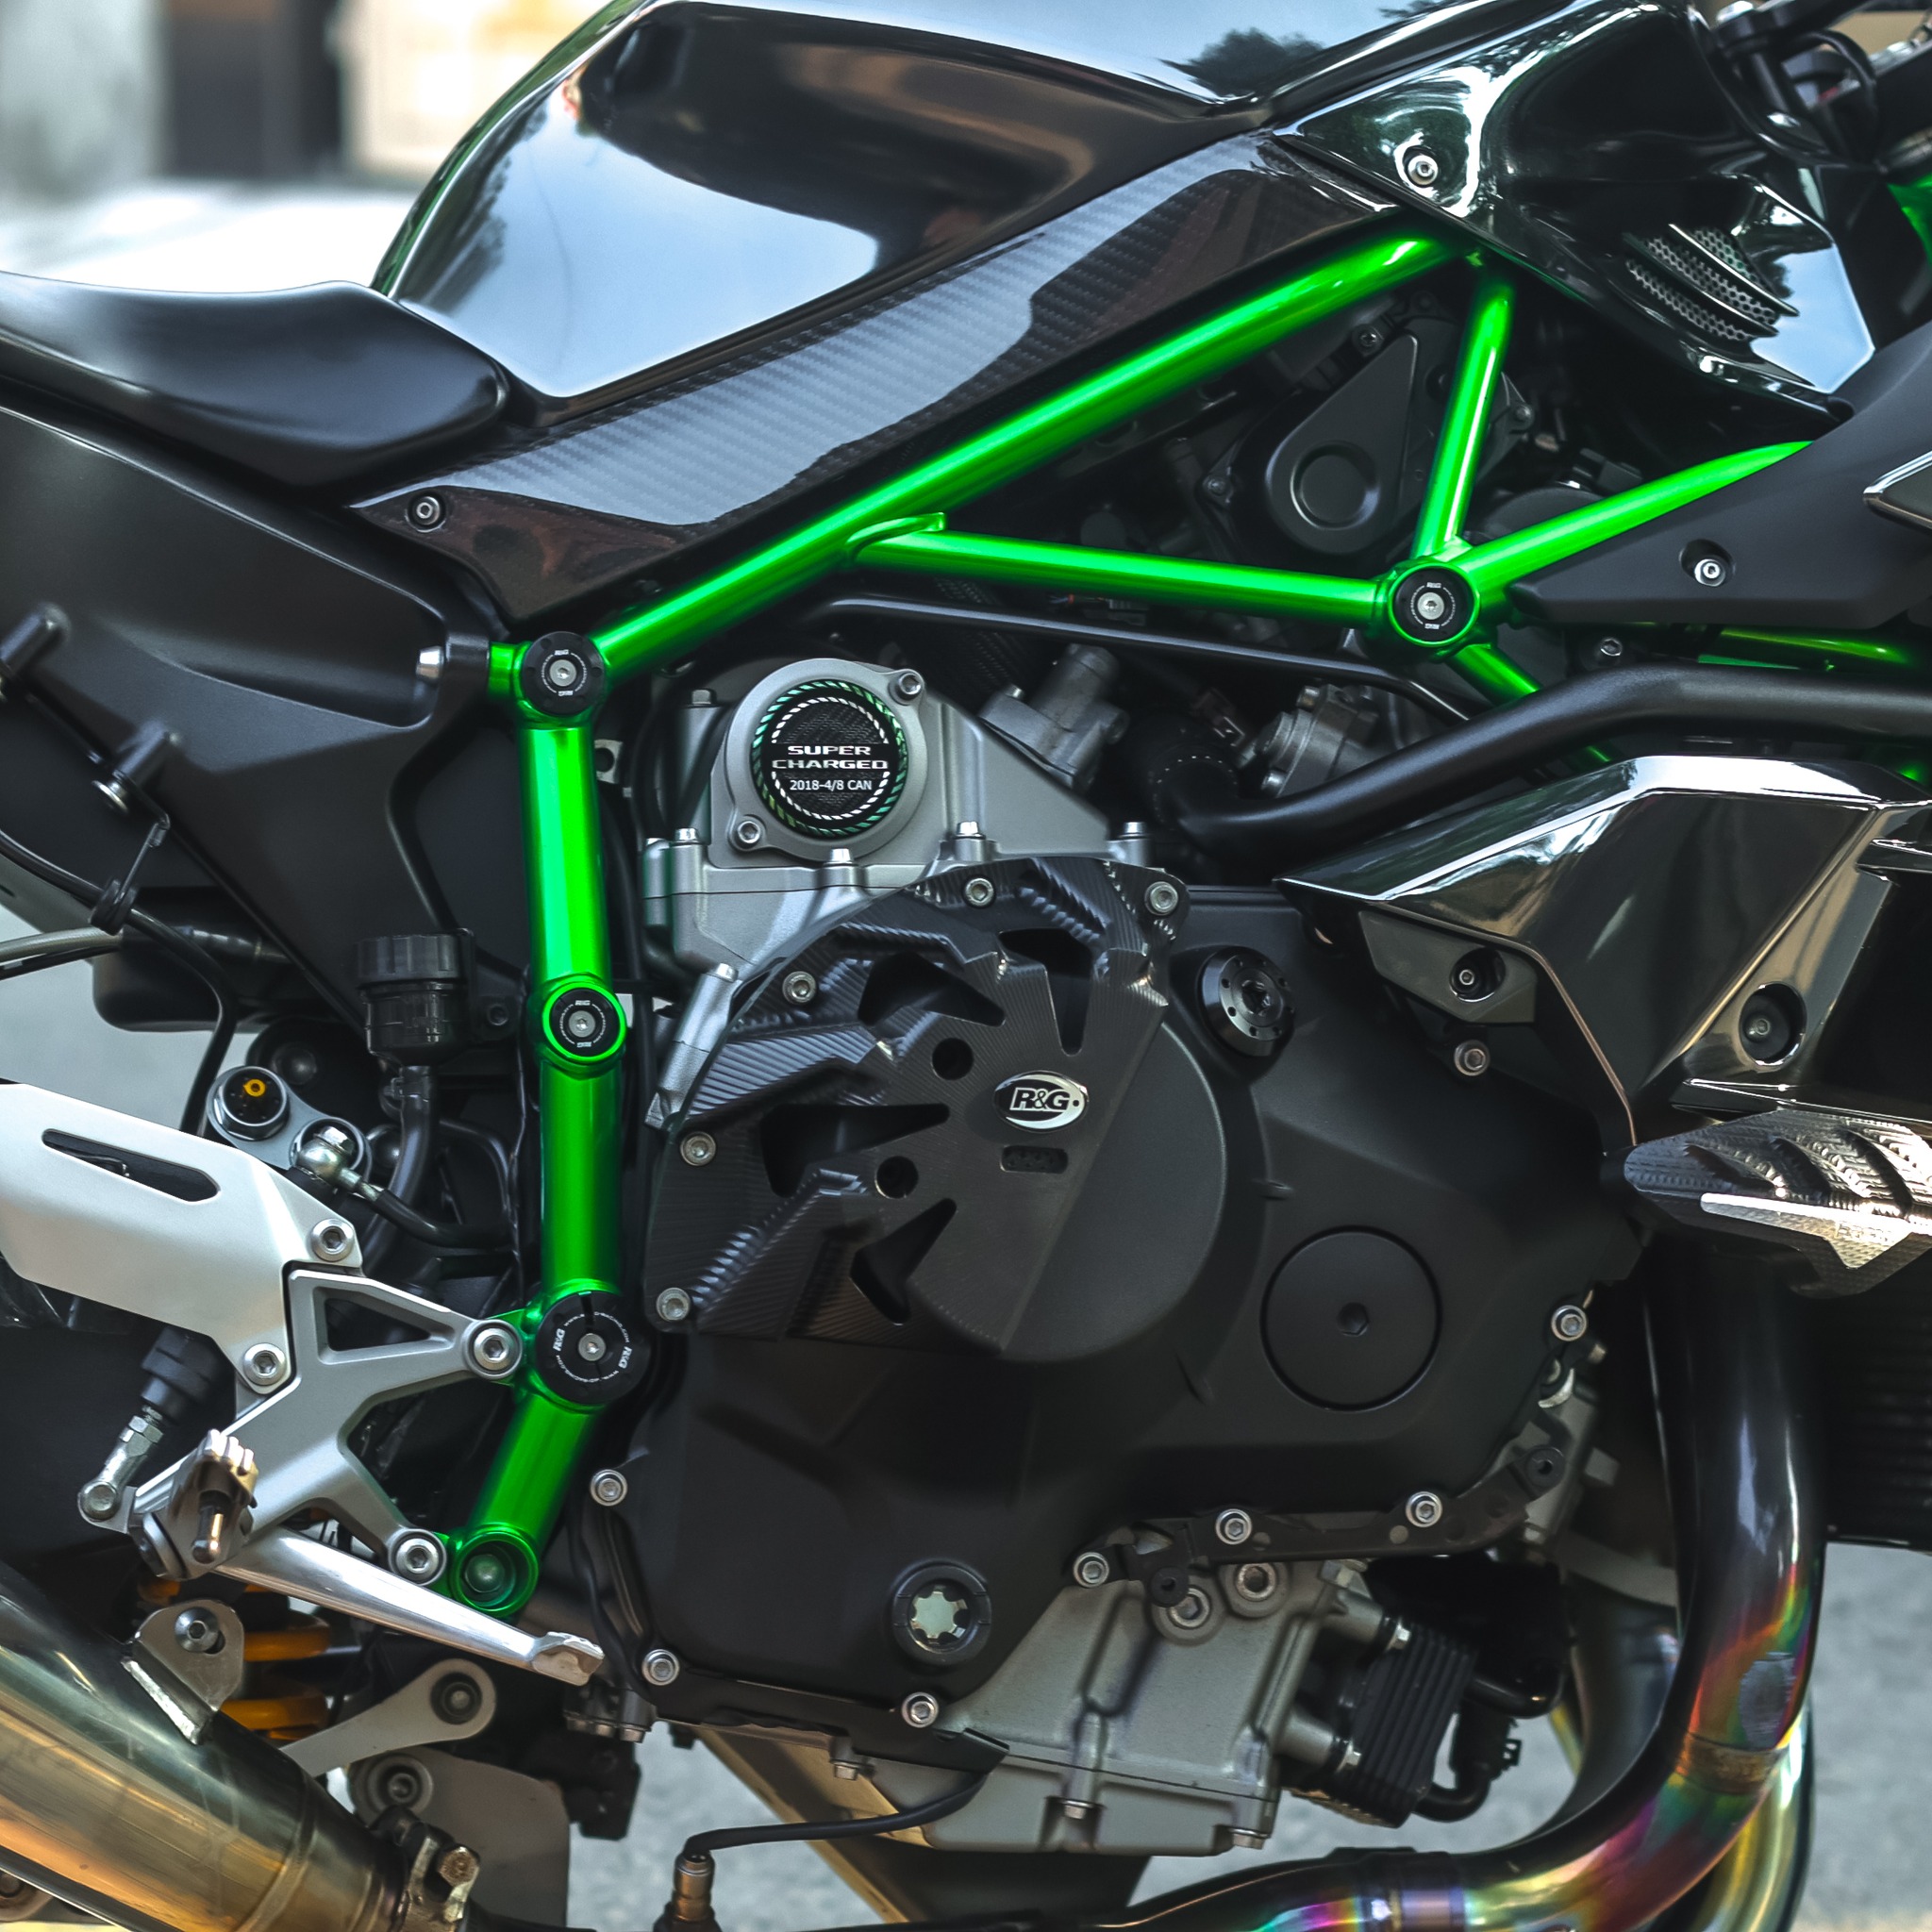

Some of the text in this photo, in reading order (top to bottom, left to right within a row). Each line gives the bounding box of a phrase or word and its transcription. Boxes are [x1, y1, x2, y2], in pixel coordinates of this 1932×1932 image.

[788, 745, 872, 756] SUPER
[772, 759, 889, 770] CHARGED
[790, 779, 872, 791] 2018-4/8 CAN
[1009, 1087, 1071, 1113] R&G
